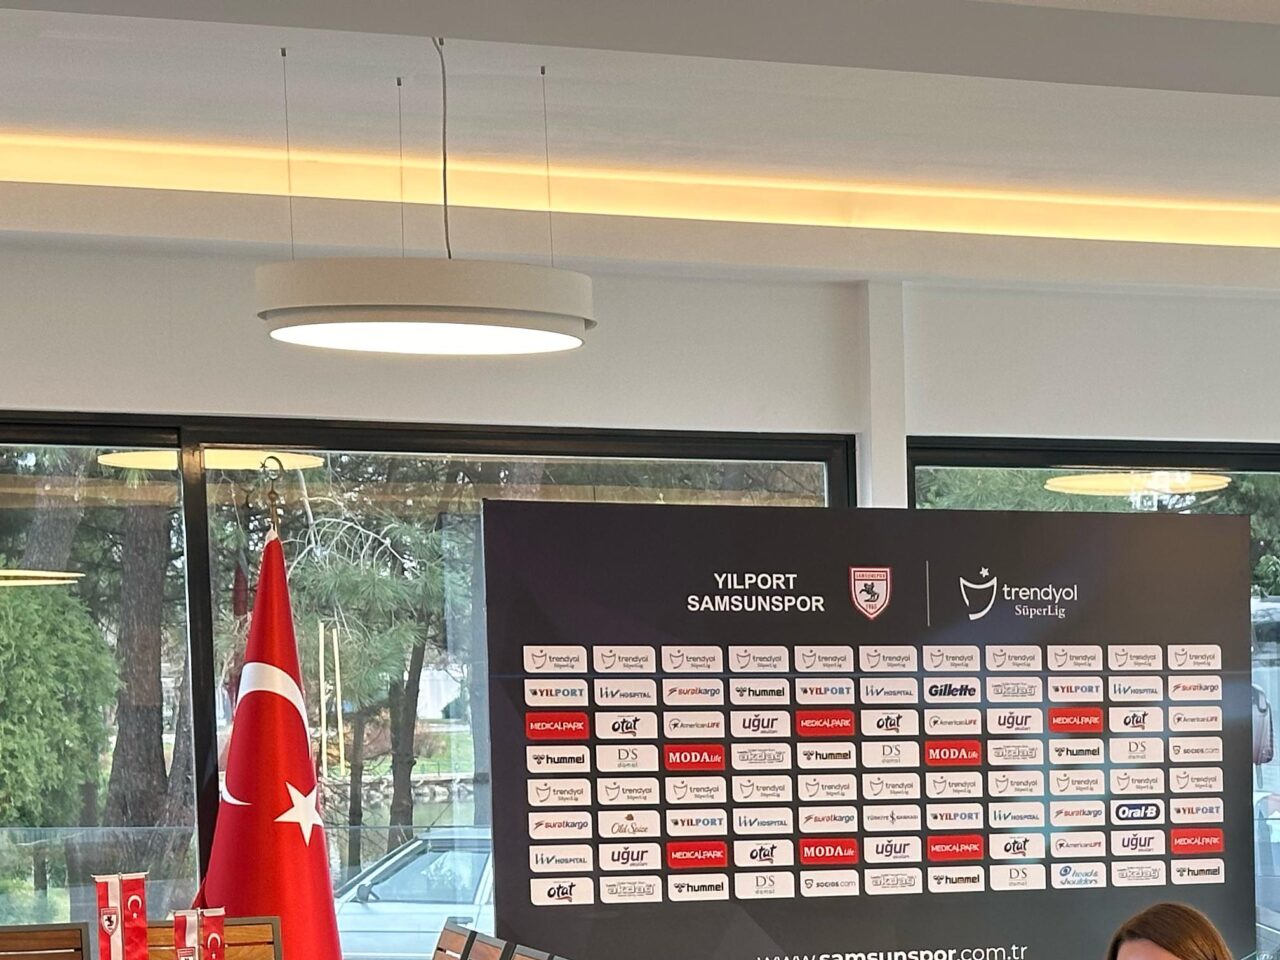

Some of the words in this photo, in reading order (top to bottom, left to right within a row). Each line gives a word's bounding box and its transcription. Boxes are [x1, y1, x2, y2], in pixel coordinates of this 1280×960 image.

[714, 573, 797, 590] YILPORT
[1002, 584, 1077, 603] trendyol
[687, 595, 825, 612] SAMSUNSPOR
[1014, 604, 1066, 618] SüperLig
[748, 687, 784, 696] hummel
[809, 687, 850, 695] YILPORT
[929, 684, 976, 696] Gillette
[743, 714, 778, 731] uğur
[998, 712, 1032, 729] uğur
[815, 751, 851, 759] hummel
[1066, 748, 1099, 756] hummel
[546, 755, 584, 764] hummel
[553, 788, 583, 796] trendyol
[1182, 806, 1220, 814] YILPORT
[938, 812, 979, 820] YILPORT
[680, 818, 723, 826] YILPORT
[1122, 834, 1154, 850] uğur
[876, 840, 910, 856] uğur
[612, 847, 648, 865] uğur
[1188, 868, 1220, 877] hummel
[945, 875, 979, 884] hummel
[687, 882, 723, 892] hummel
